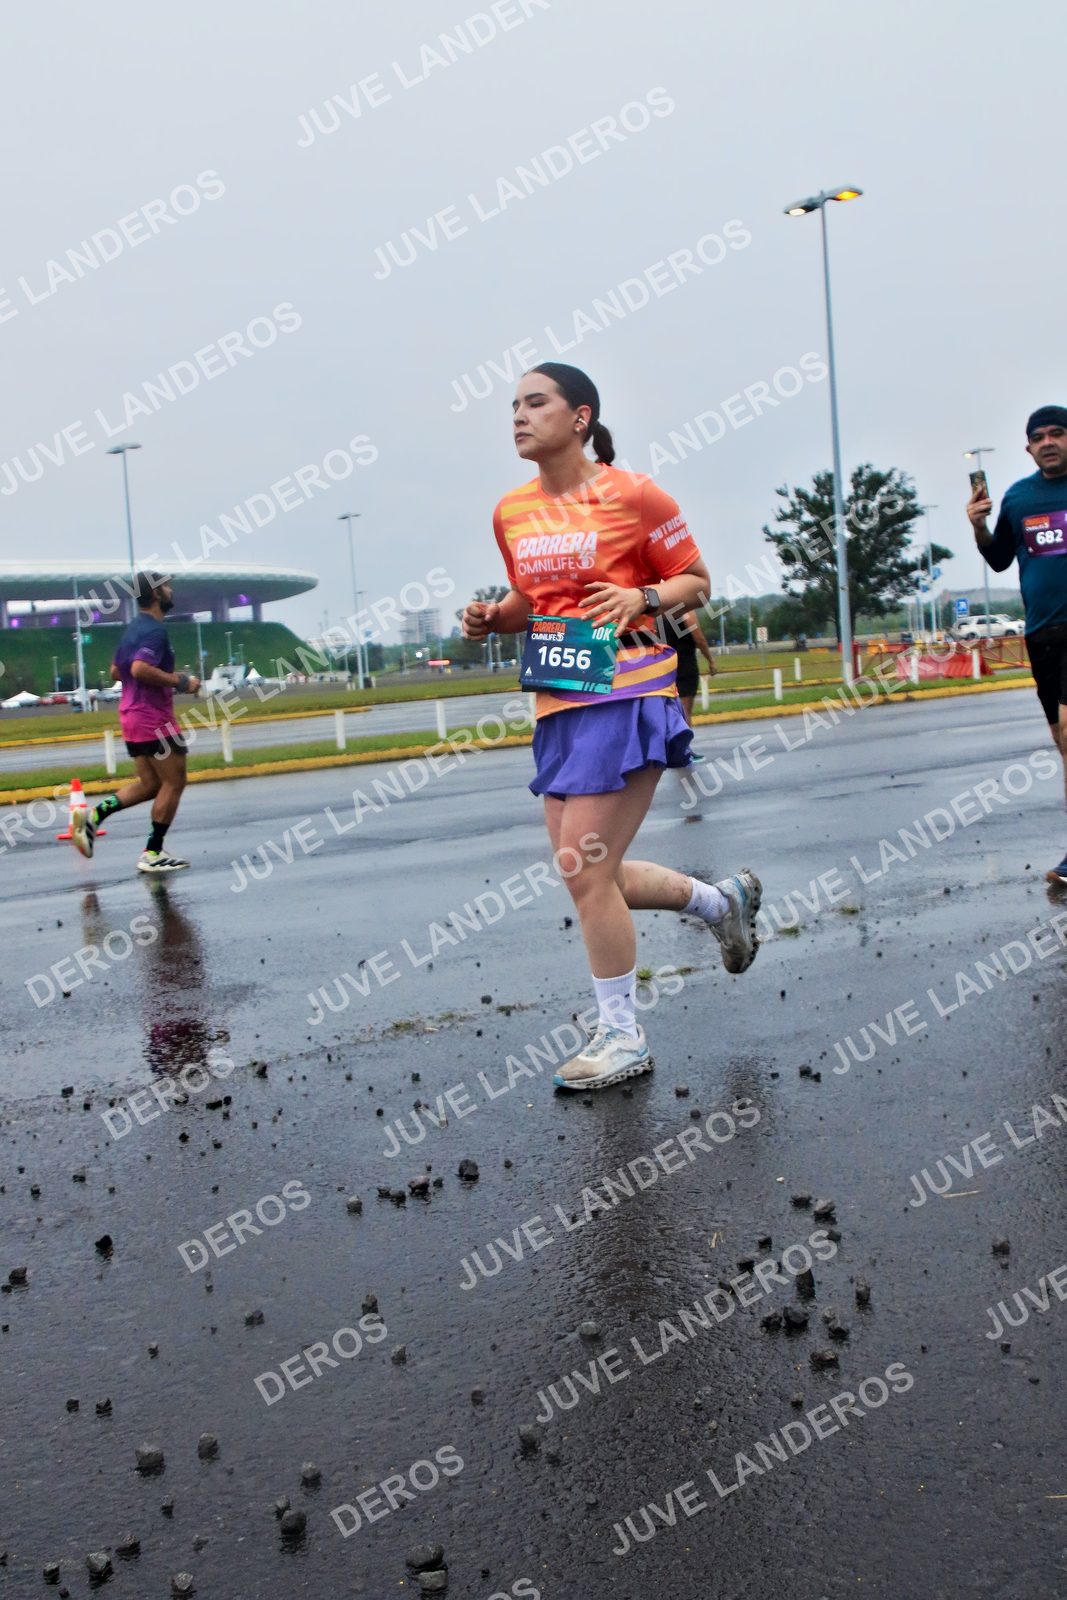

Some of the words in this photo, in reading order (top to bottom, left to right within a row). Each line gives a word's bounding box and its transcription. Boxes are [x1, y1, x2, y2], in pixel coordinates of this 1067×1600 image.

[517, 531, 597, 560] CARRERA
[1036, 529, 1063, 545] 682
[518, 556, 575, 576] OMNILIFE
[532, 621, 566, 633] CARRERA
[592, 627, 613, 642] 10K
[538, 645, 591, 670] 1656
